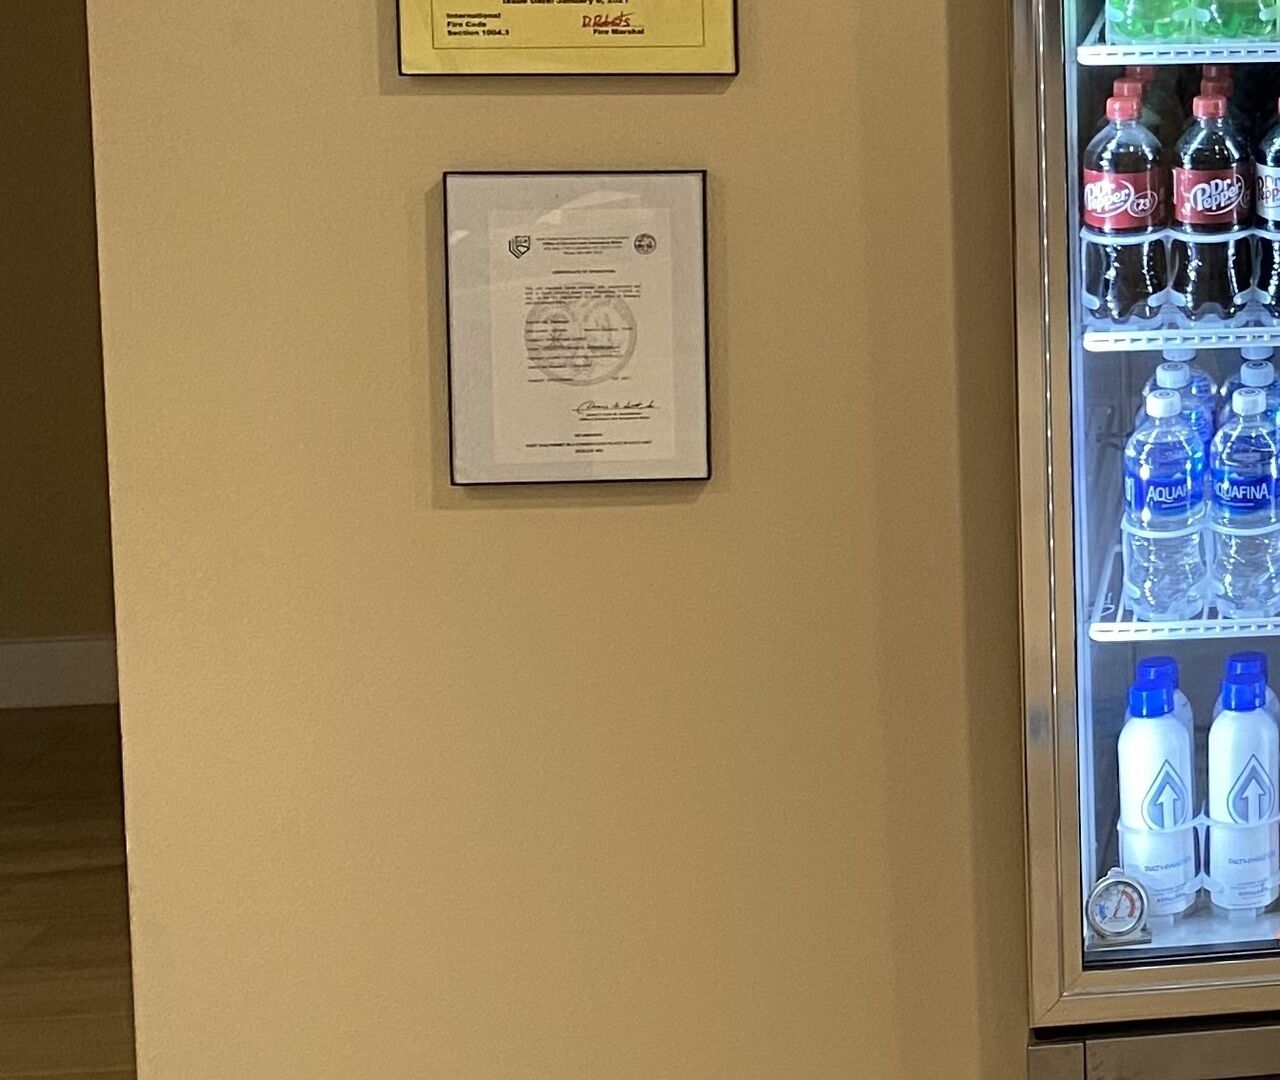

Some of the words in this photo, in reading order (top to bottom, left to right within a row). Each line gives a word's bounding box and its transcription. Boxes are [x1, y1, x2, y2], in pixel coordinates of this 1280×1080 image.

[1191, 179, 1242, 212] Pepper
[1210, 176, 1231, 195] Dr
[1085, 184, 1129, 212] Pepper
[1137, 198, 1150, 210] 23
